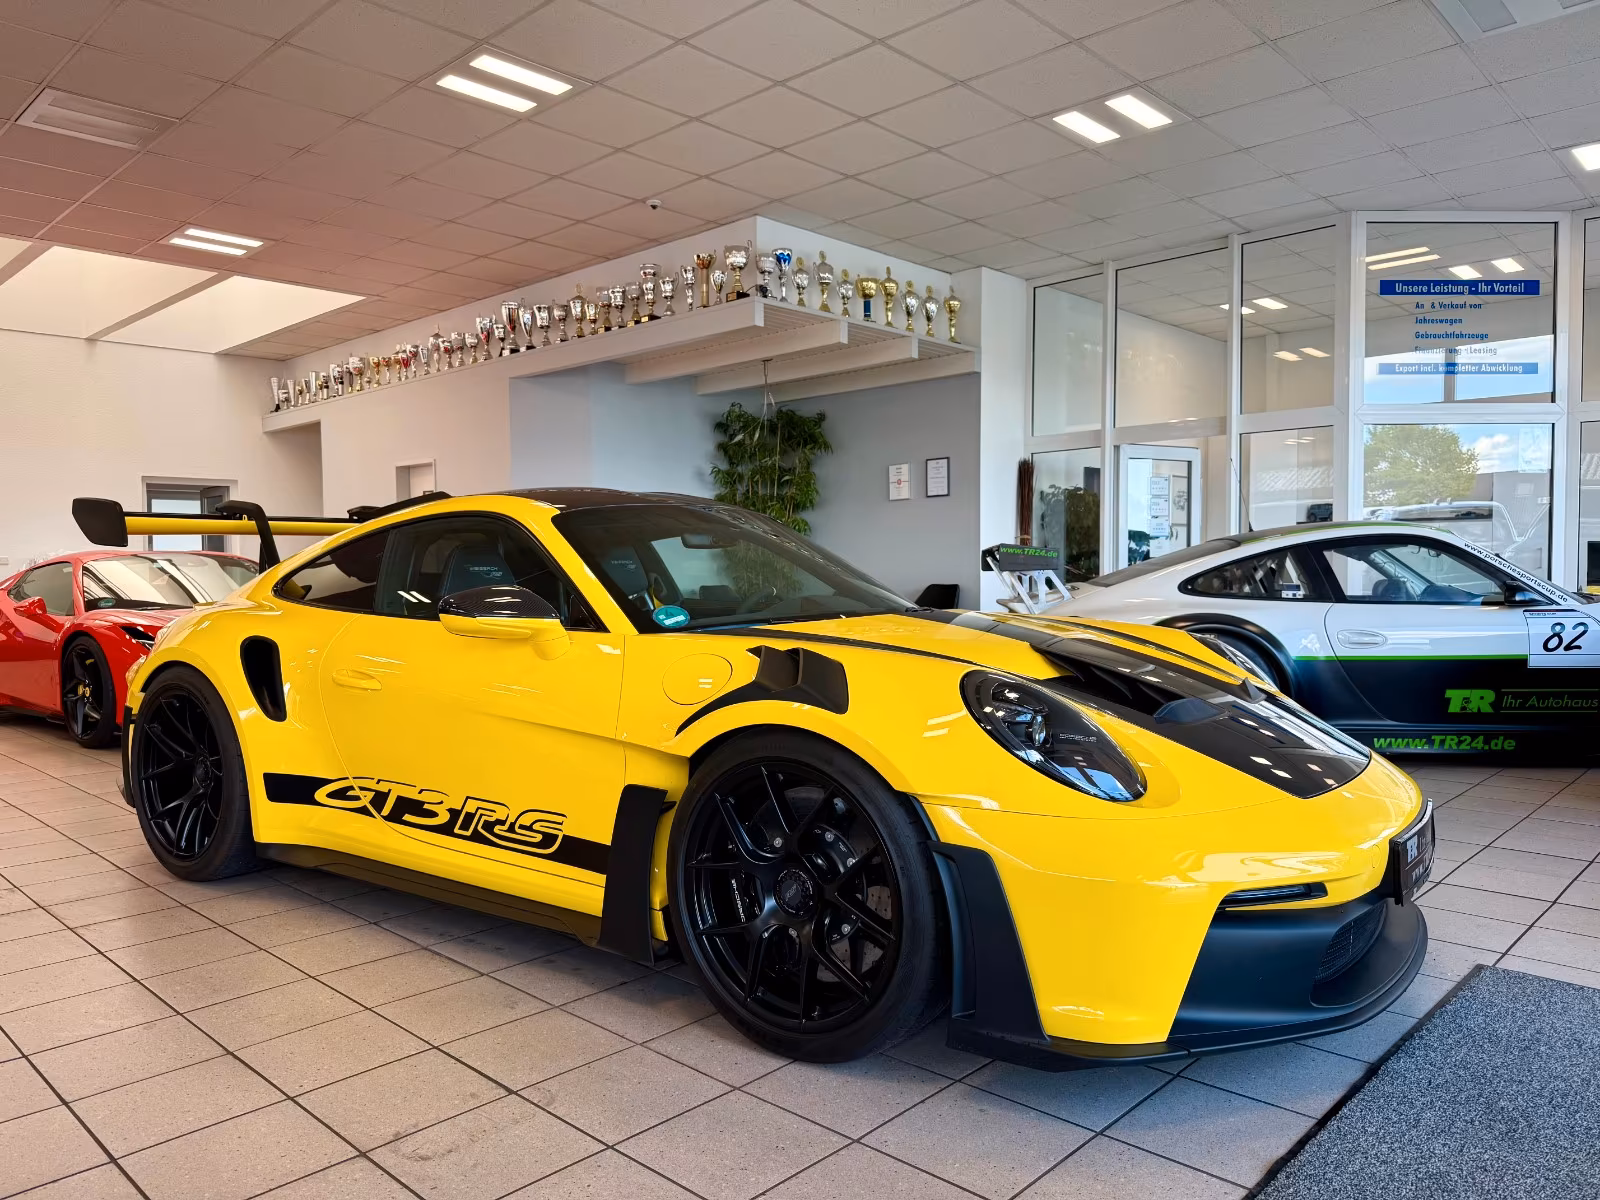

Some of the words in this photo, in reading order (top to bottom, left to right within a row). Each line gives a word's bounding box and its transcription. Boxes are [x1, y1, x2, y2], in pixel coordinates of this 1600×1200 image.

[1395, 282, 1428, 293] Unsere
[1430, 282, 1469, 295] Leistung
[1478, 282, 1491, 293] Ihr
[1493, 282, 1525, 293] Vorteil
[1415, 302, 1425, 310] An
[1430, 302, 1436, 310] &
[1438, 301, 1467, 310] Verkauf
[1415, 316, 1463, 326] Jahreswagen
[1414, 331, 1489, 341] Gebrauchtfahrzeuge
[1470, 346, 1498, 356] Leasing
[1395, 363, 1418, 374] Export
[1420, 363, 1436, 373] incl.
[1480, 363, 1523, 374] Abwicklung
[1000, 547, 1059, 558] www.TR24.de
[1463, 541, 1569, 603] www.porschesportscup.de
[1542, 621, 1590, 653] 82
[1502, 694, 1523, 708] Ihr
[1525, 694, 1599, 708] Autohaus
[1373, 734, 1516, 750] www.TR24.de
